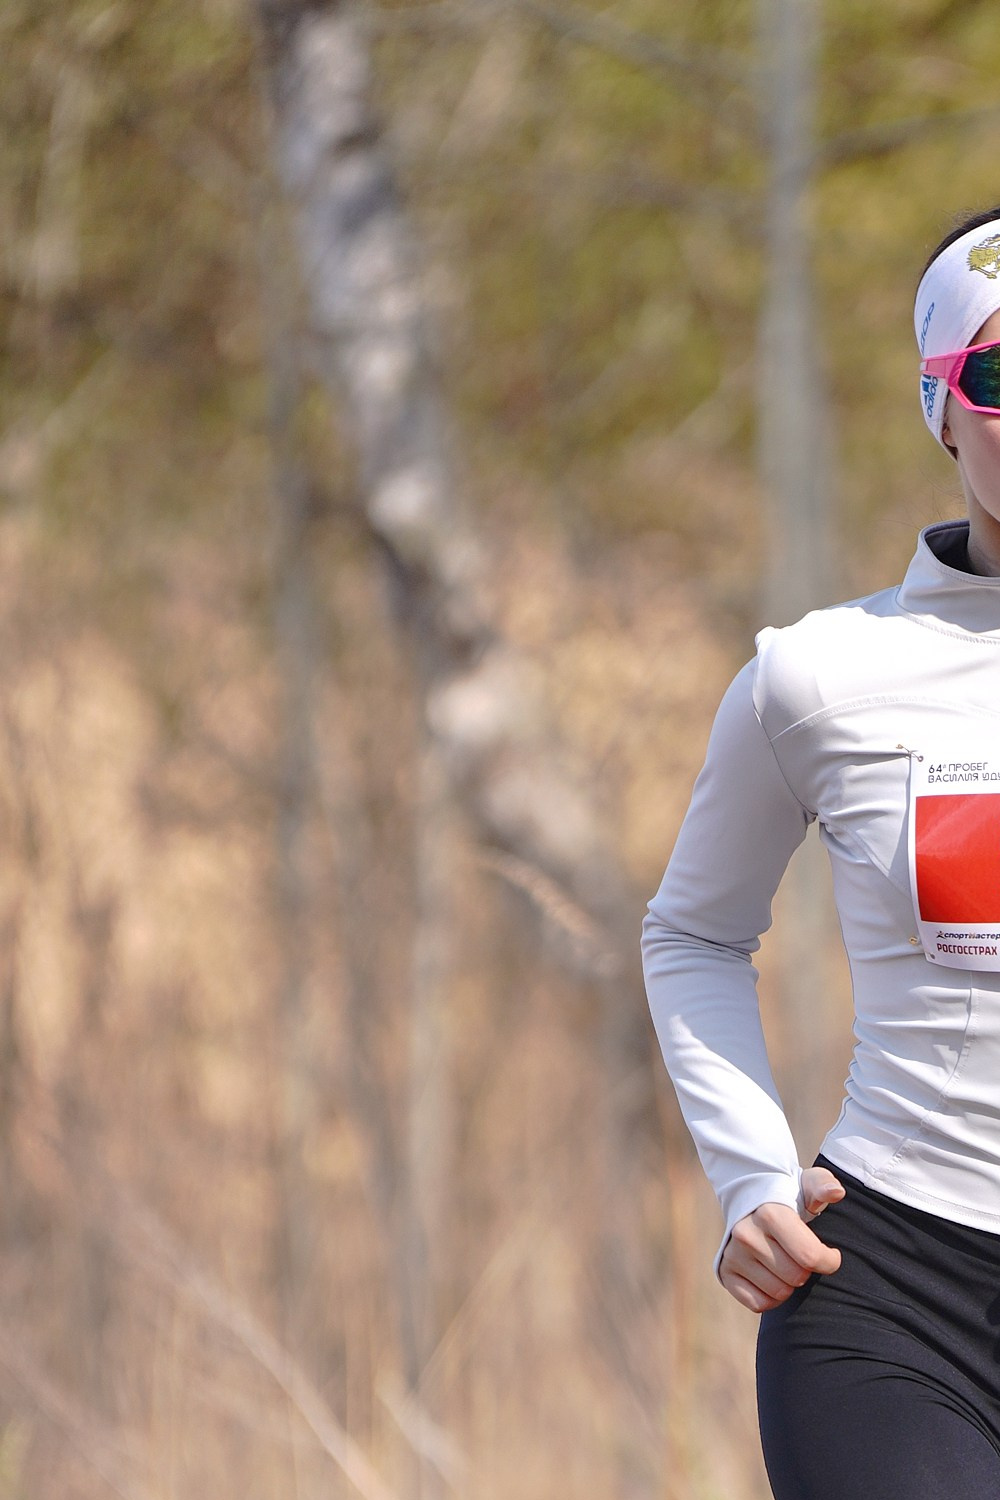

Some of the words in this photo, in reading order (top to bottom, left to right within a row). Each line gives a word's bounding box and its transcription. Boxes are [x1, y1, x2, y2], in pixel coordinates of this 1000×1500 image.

[926, 376, 938, 418] adida
[948, 762, 988, 772] ПРОБЕГ
[928, 772, 979, 784] ВАСИЛИЯ
[936, 943, 998, 956] РОСГОССТРАХ
